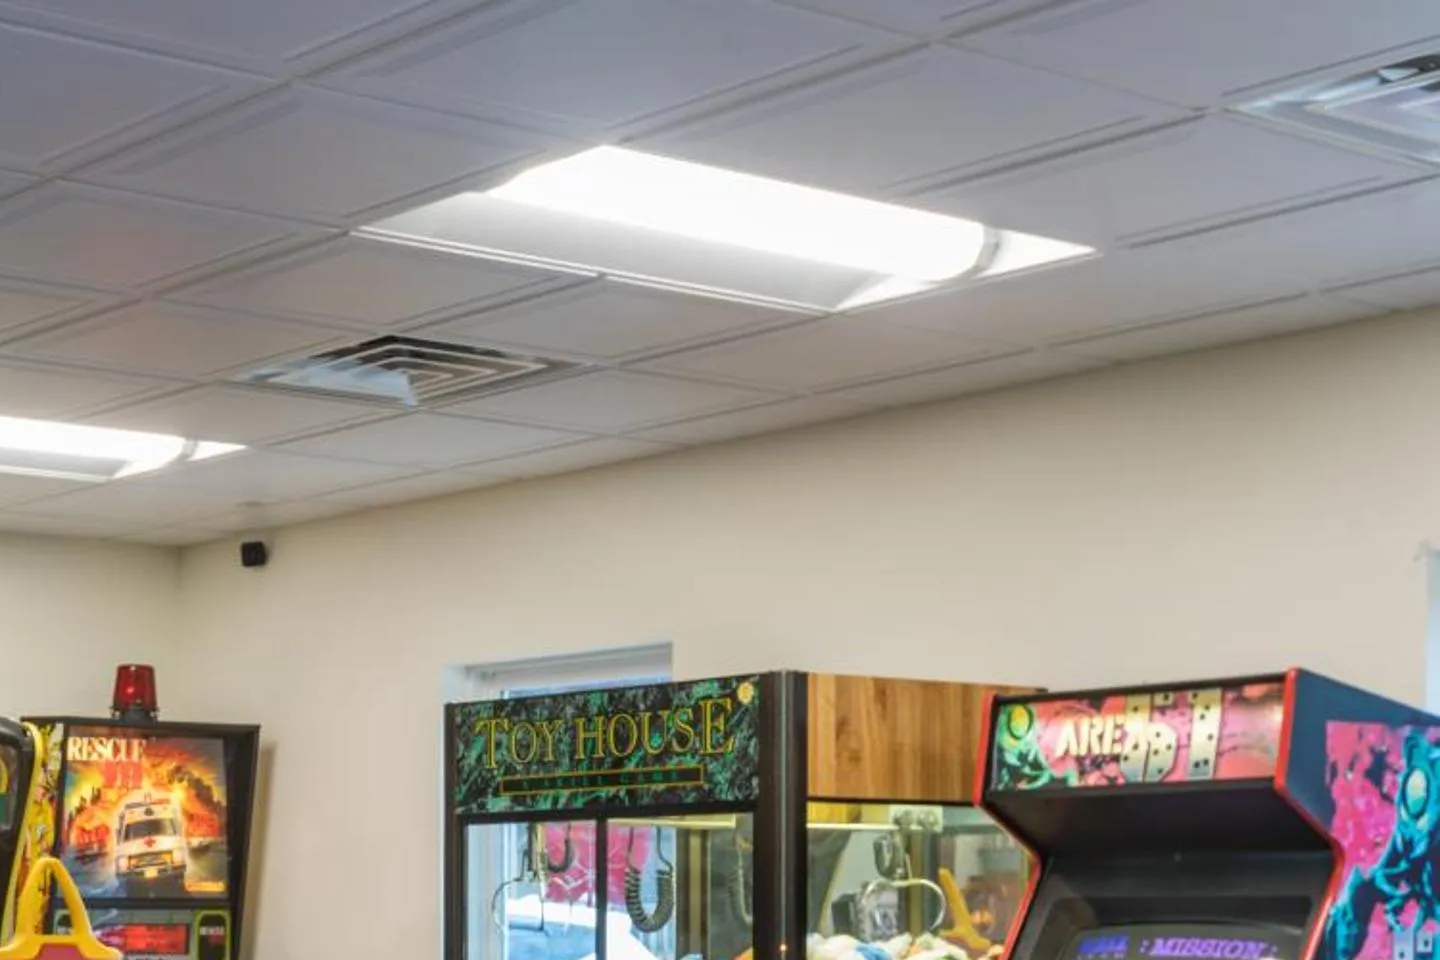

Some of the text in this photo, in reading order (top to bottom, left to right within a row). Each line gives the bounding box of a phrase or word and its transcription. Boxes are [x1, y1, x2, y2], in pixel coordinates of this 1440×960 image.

[66, 735, 147, 762] RESCUE
[474, 698, 735, 769] TOY HOUSE
[1055, 687, 1223, 783] AREA 51
